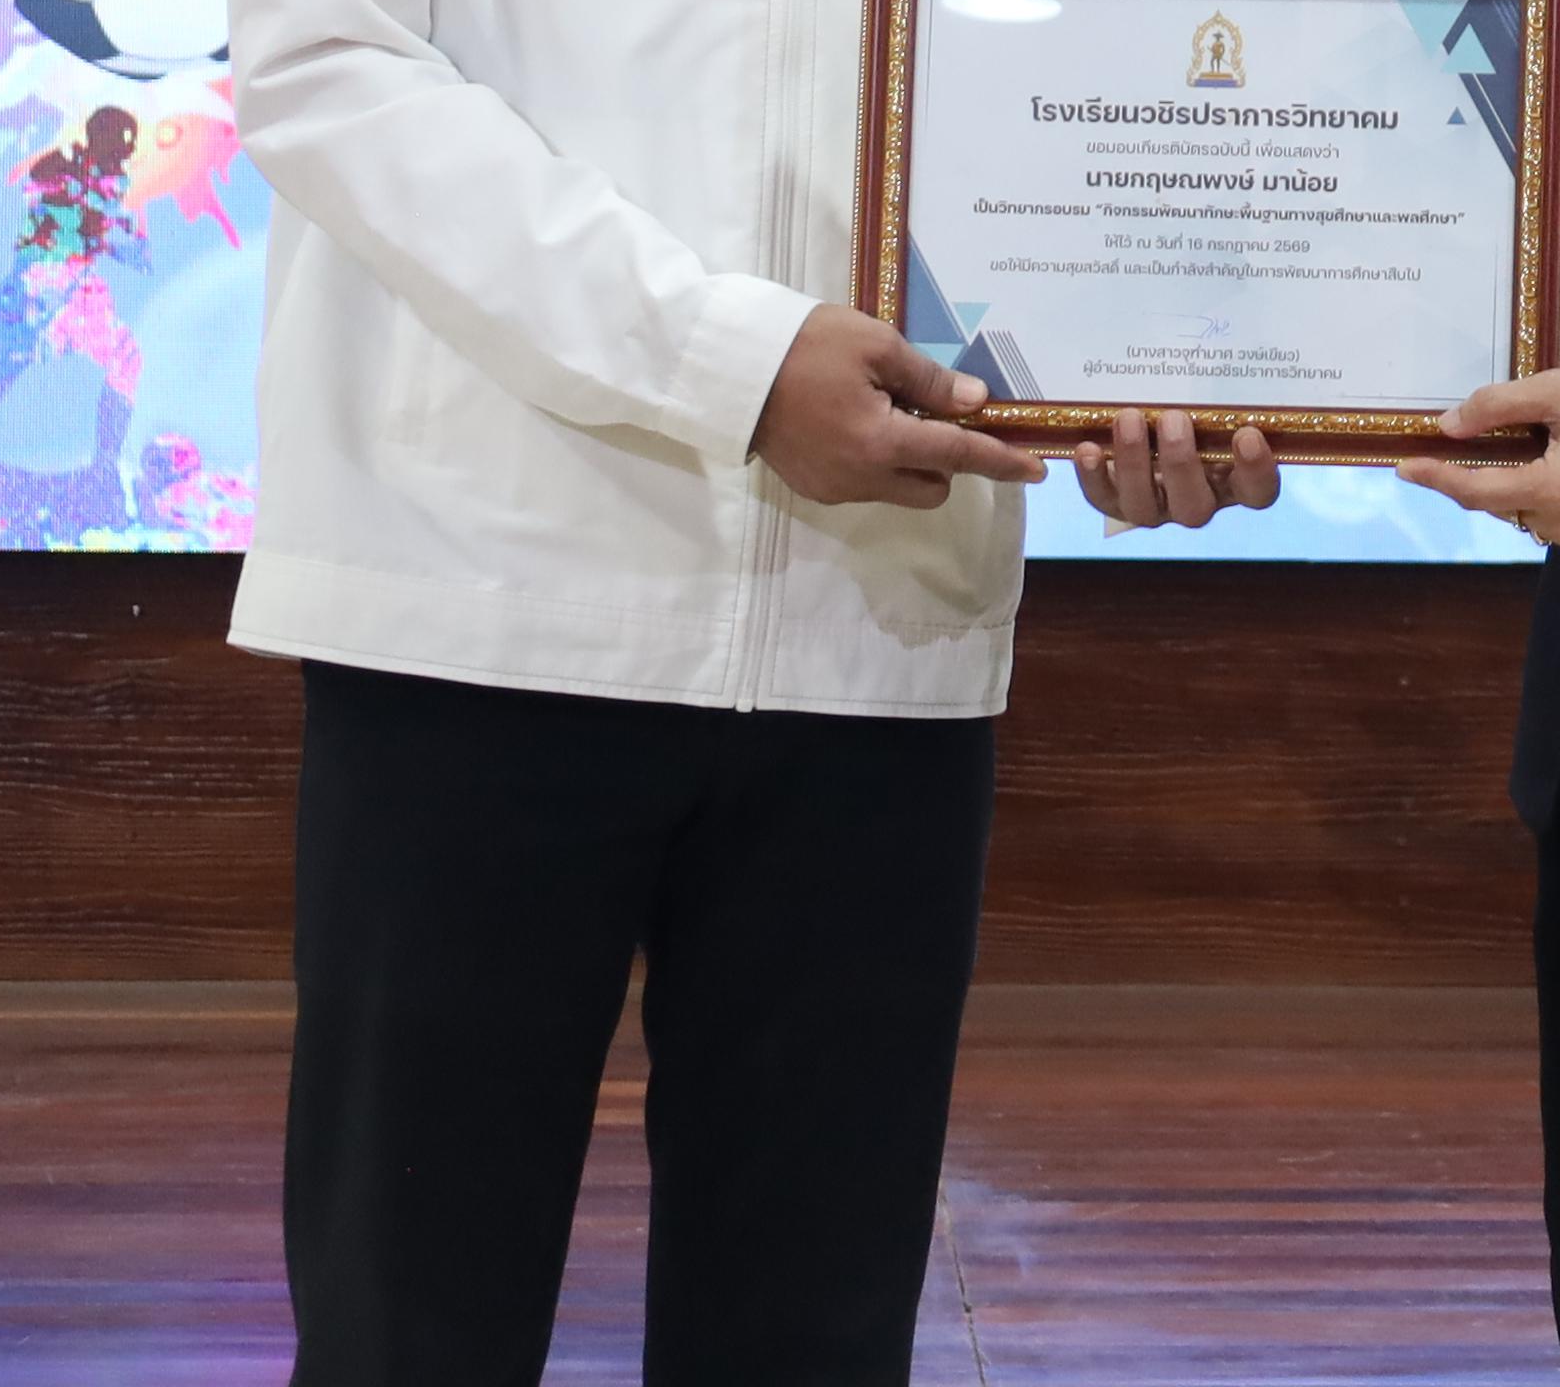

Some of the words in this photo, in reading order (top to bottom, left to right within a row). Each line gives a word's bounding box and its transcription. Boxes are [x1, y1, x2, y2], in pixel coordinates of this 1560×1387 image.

[1031, 96, 1399, 130] โรงเรียนวชิรปราการวิทยาคม
[1086, 139, 1250, 157] ขอมอบเกียรติบัตรฉบับนี้
[1256, 139, 1340, 159] เพื่อแสดงว่า
[1086, 168, 1255, 193] นายกฤษณพงษ์
[1263, 168, 1338, 192] มาน้อย
[973, 198, 1091, 216] เป็นวิทยากรอบรม
[1104, 234, 1132, 249] ให้ไว้
[1137, 237, 1151, 250] ณ
[1155, 233, 1183, 250] วันที่
[1188, 238, 1203, 250] 16
[1207, 239, 1270, 254] กรกฎาคม
[1082, 359, 1343, 380] ผู้อำนวยการโรงเรียนวชิรปราการวิทยาคม
